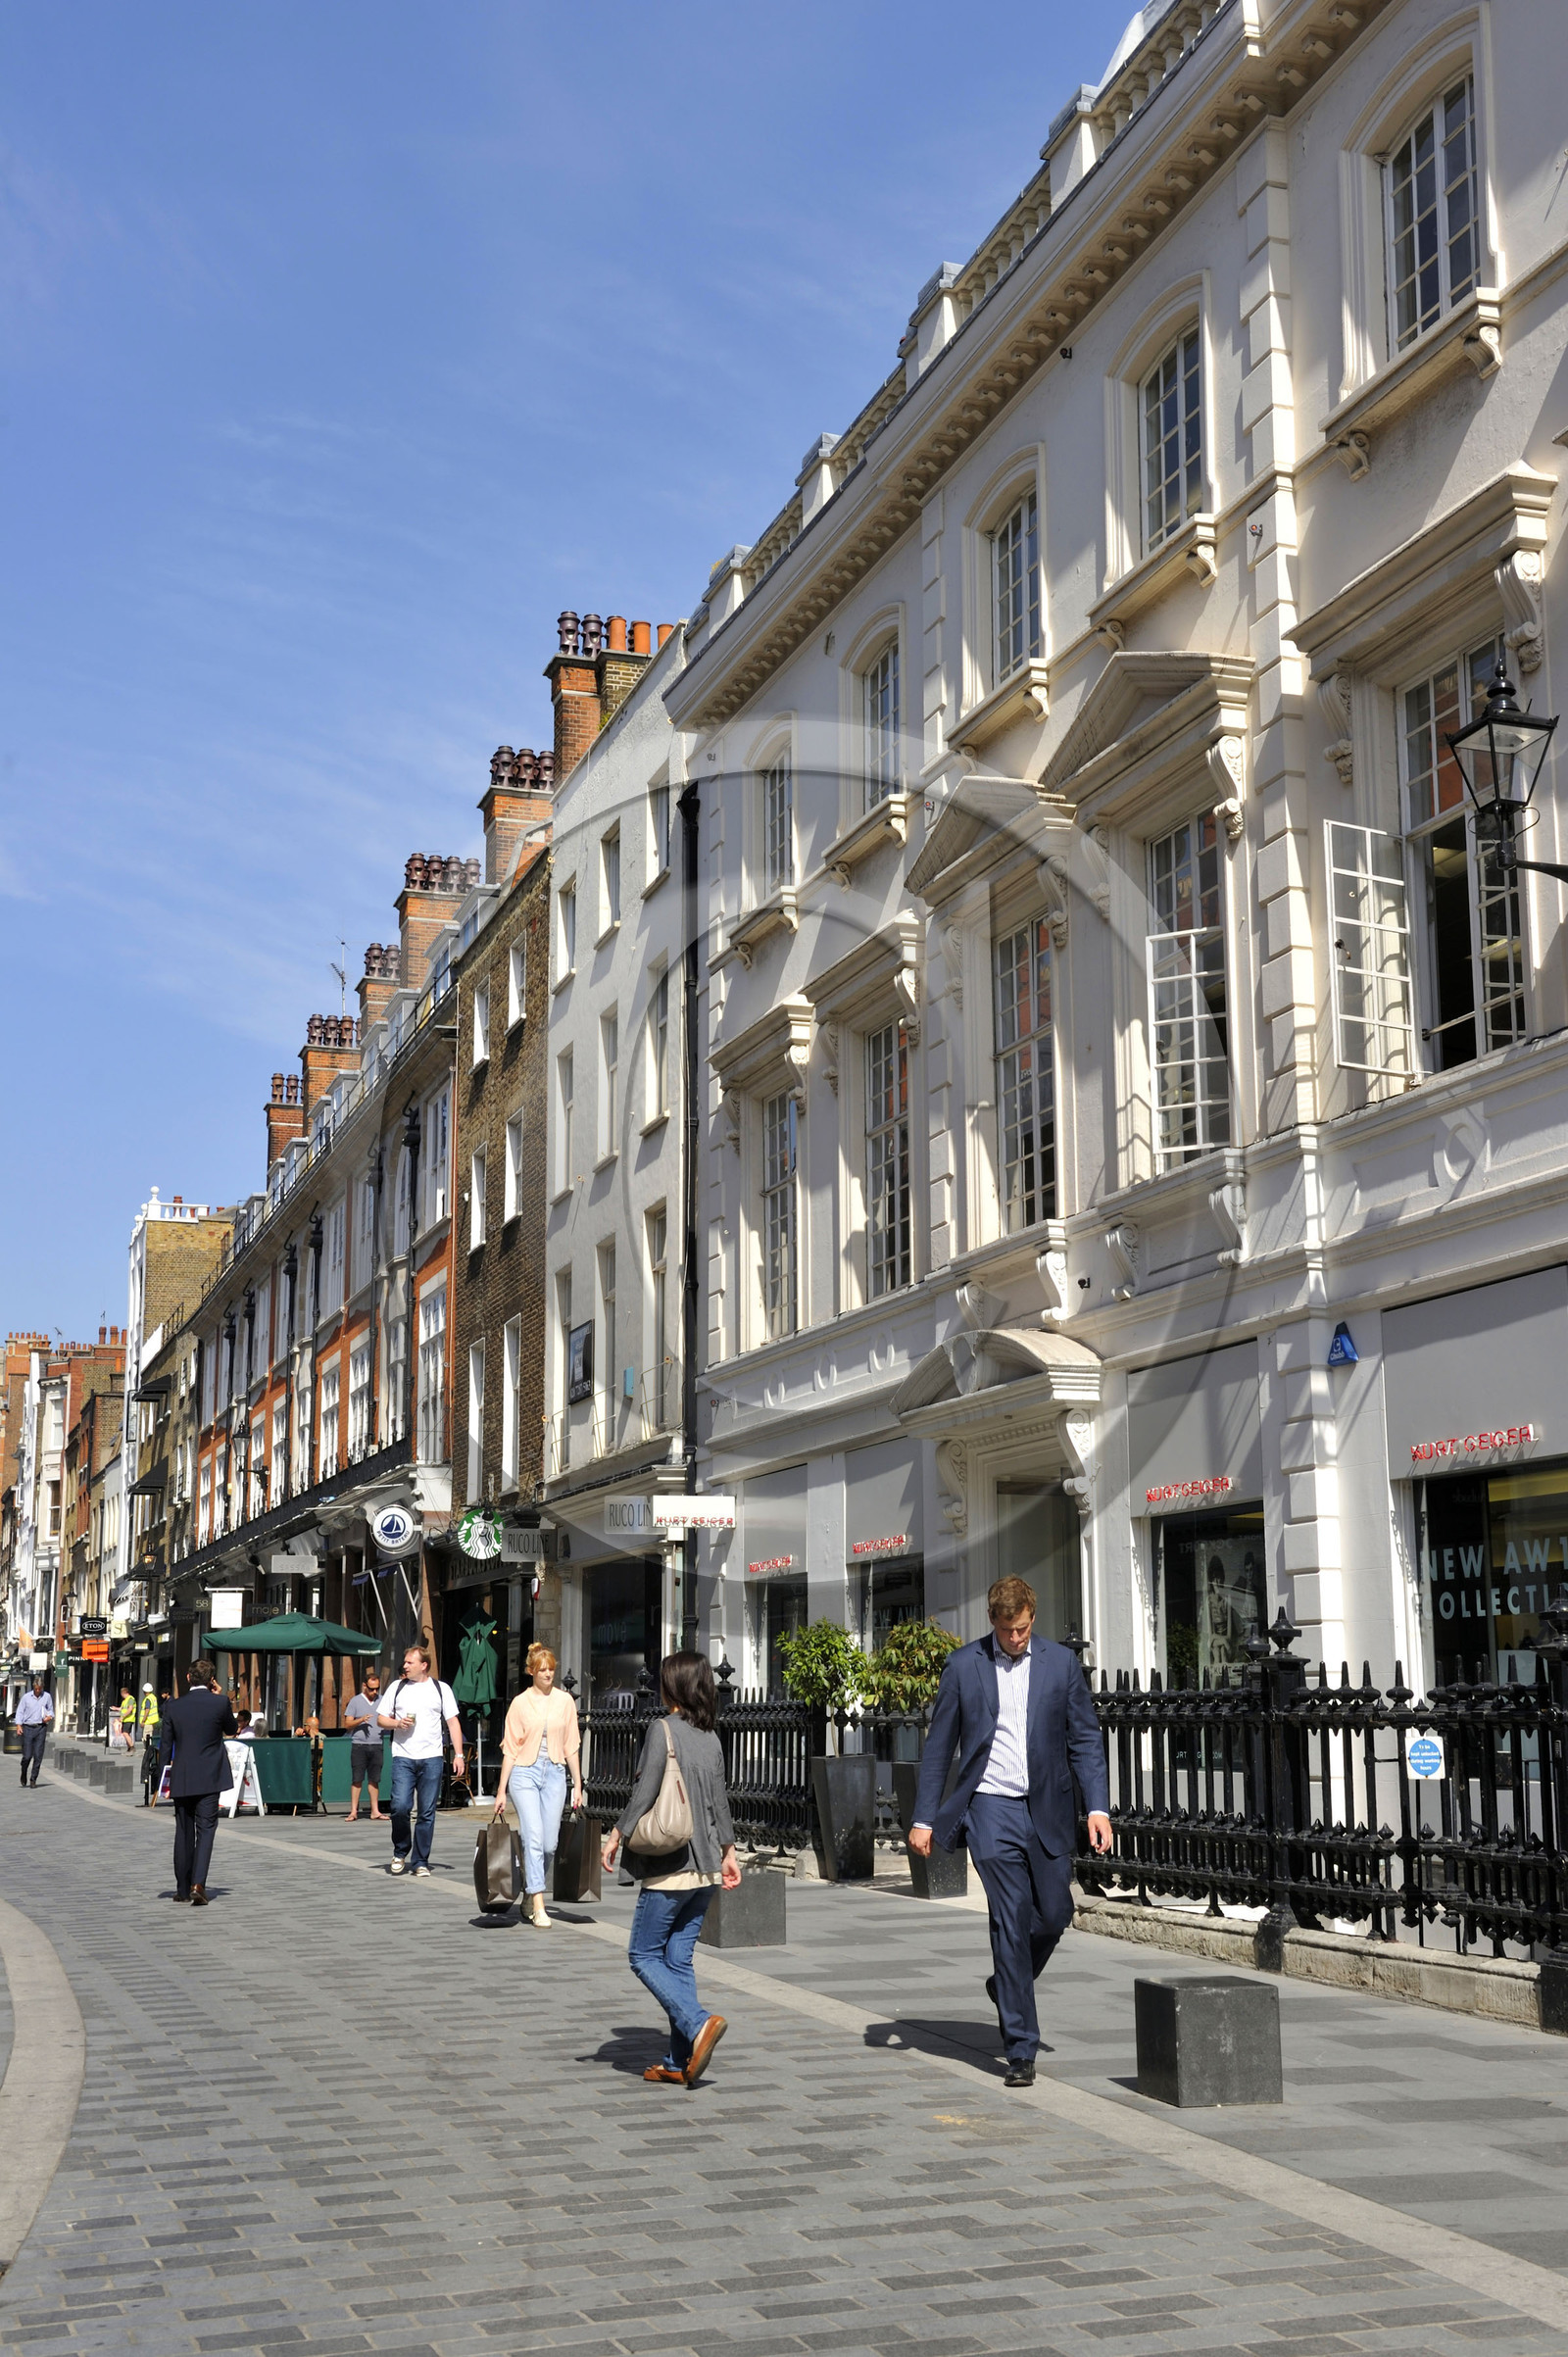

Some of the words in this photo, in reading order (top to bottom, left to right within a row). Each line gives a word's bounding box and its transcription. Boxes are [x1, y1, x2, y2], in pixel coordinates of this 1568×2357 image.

[1410, 1437, 1458, 1461] KURT
[1464, 1424, 1536, 1453] GEIGER
[1146, 1483, 1180, 1502] KURT
[1181, 1476, 1232, 1498] GEIGER
[609, 1503, 635, 1527] RUCO
[376, 1530, 390, 1544] PETIT
[391, 1530, 411, 1545] BATEAU
[508, 1533, 530, 1554] RUCO
[531, 1534, 550, 1554] LINE
[1420, 1545, 1484, 1582] NEW
[196, 1599, 209, 1608] 58
[1421, 1582, 1568, 1620] COLLECTI
[599, 1623, 627, 1652] move
